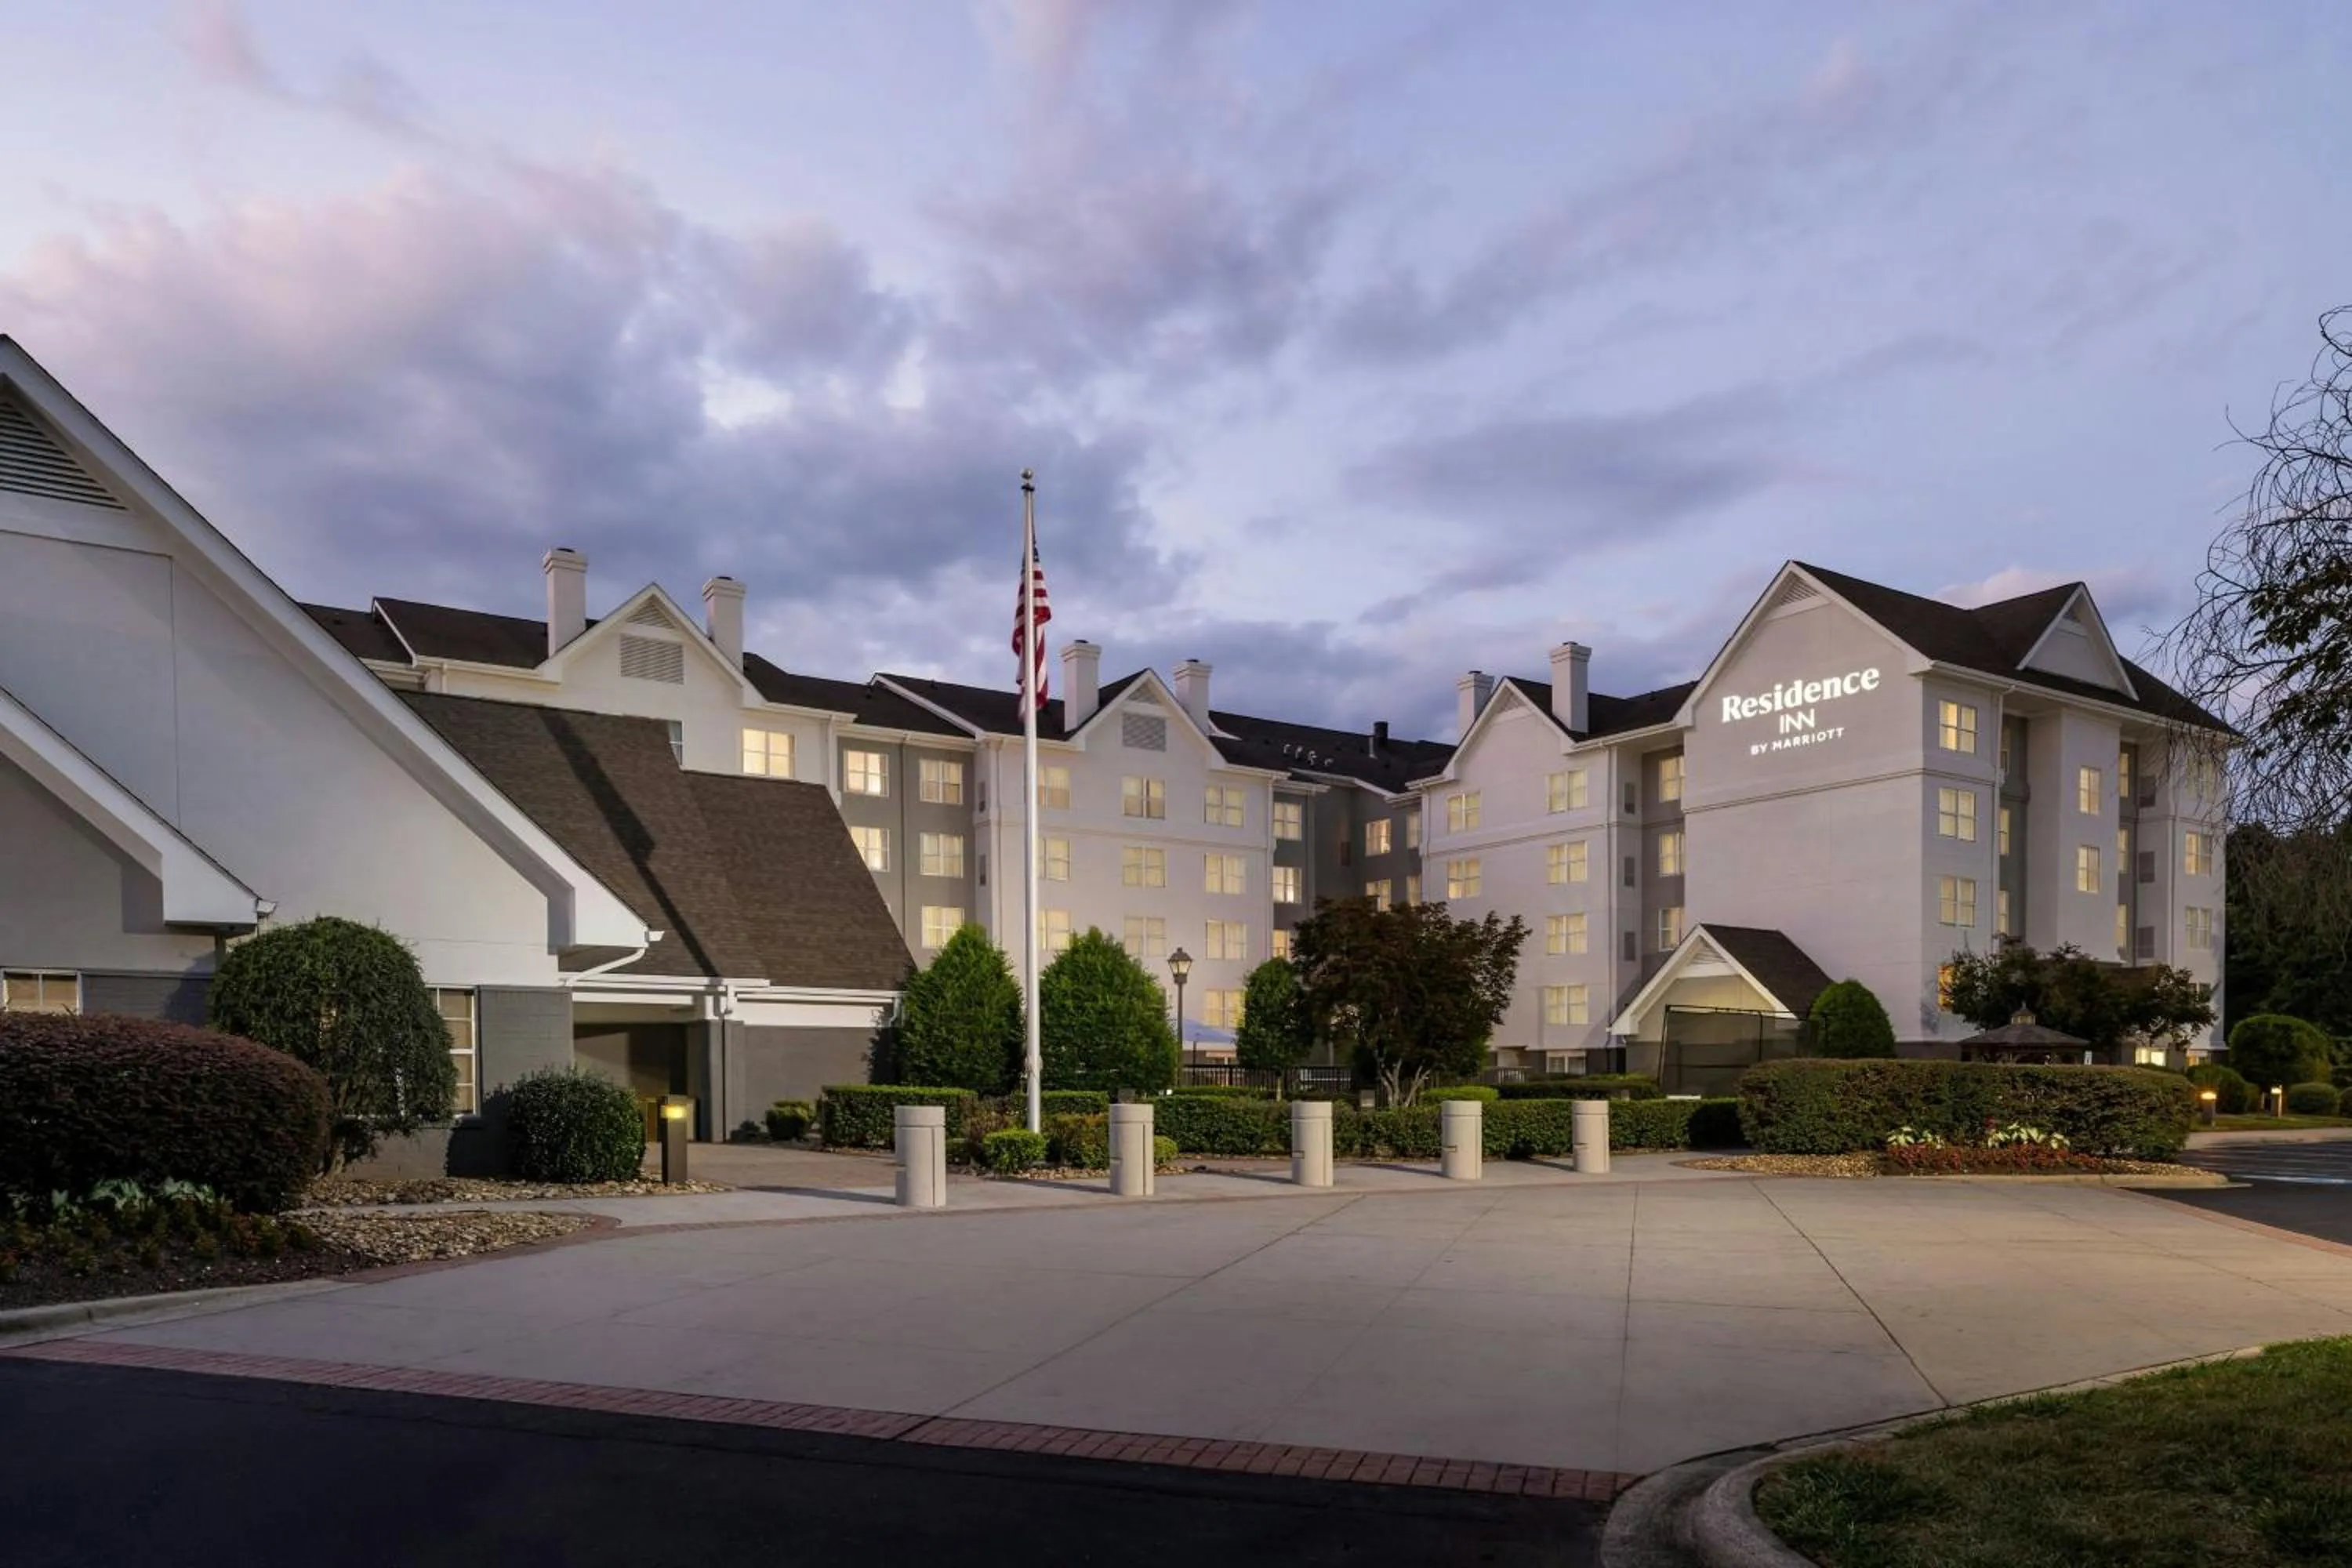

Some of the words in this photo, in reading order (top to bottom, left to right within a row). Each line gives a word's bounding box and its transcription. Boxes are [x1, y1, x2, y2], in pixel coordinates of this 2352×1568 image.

[1722, 668, 1880, 723] Residence
[1779, 709, 1815, 734] INN
[1750, 744, 1769, 756] BY
[1772, 728, 1845, 750] MARRIOTT
